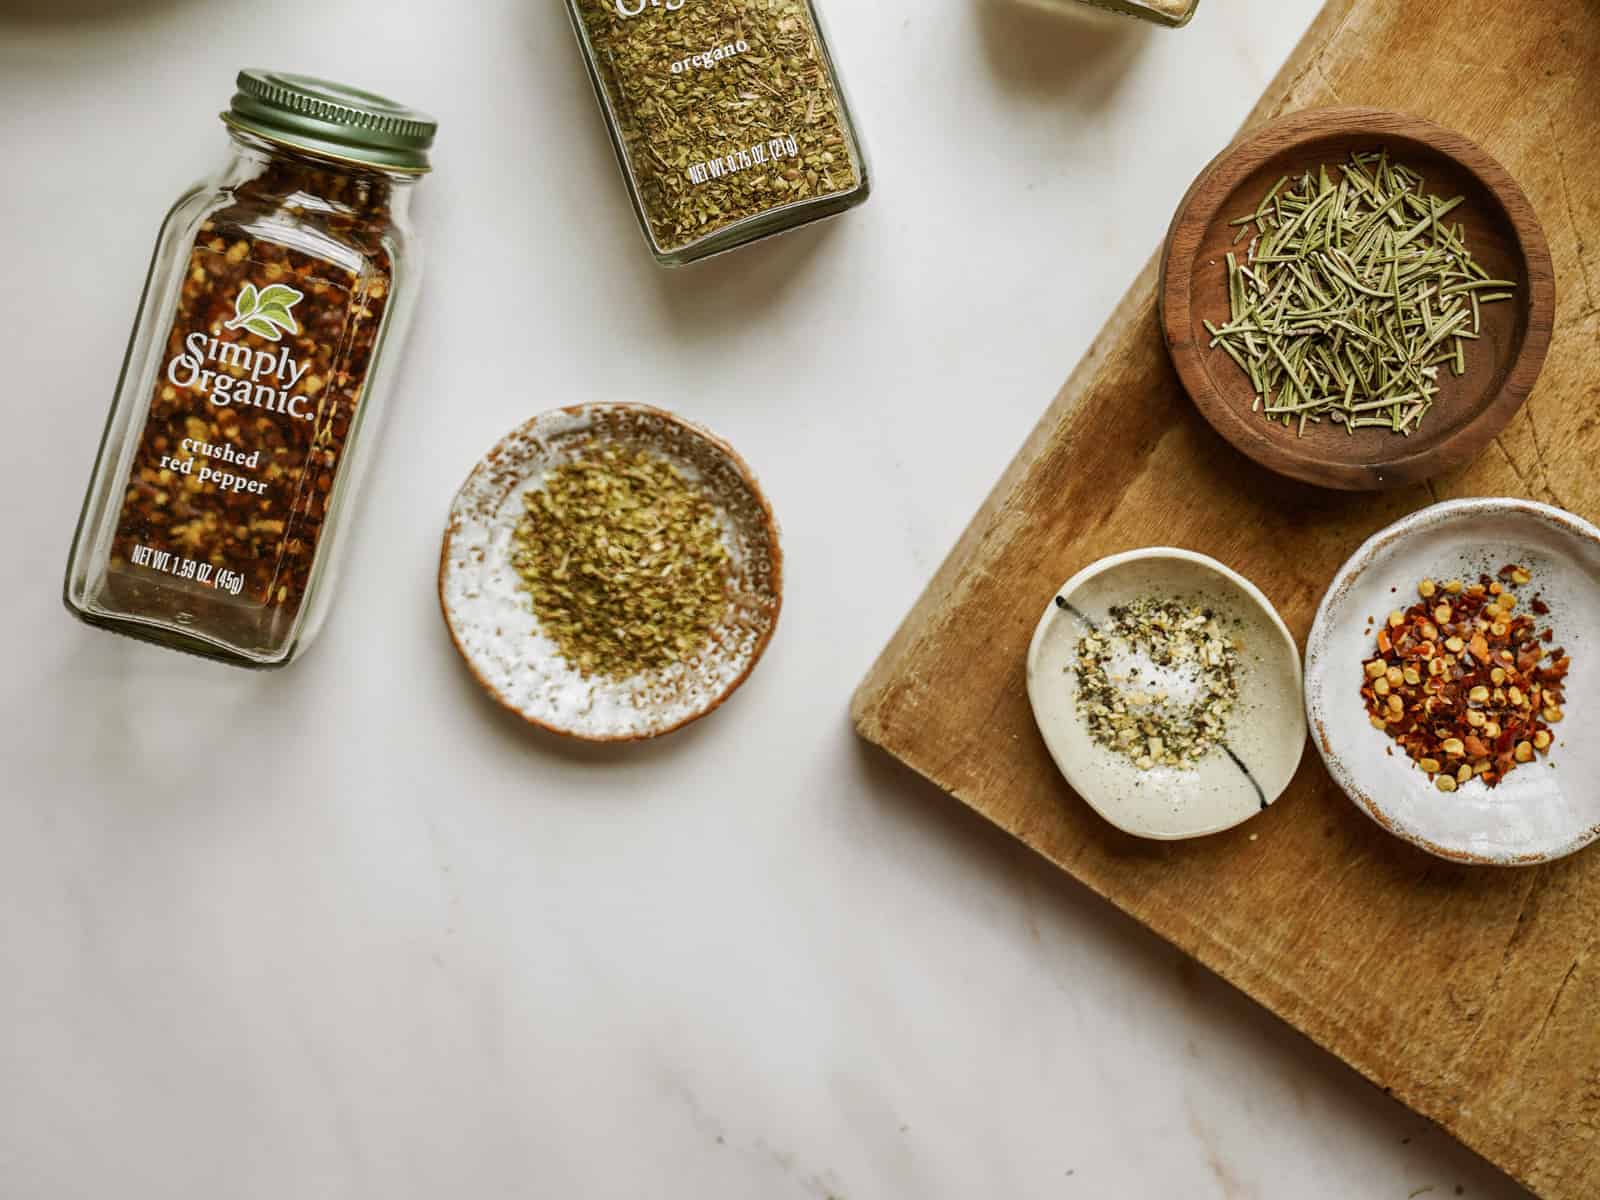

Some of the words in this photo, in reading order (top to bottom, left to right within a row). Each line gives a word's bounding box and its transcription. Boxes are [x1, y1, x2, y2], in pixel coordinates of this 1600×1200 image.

[671, 39, 748, 74] oregano
[688, 162, 709, 185] NET
[727, 150, 752, 173] 0.75
[767, 134, 799, 161] (21g)
[185, 329, 311, 390] Simply
[182, 436, 260, 469] crushed
[160, 456, 194, 475] red
[198, 464, 269, 496] pepper
[131, 544, 153, 566] NET
[171, 556, 197, 579] 1.59
[214, 567, 244, 595] (45g)
